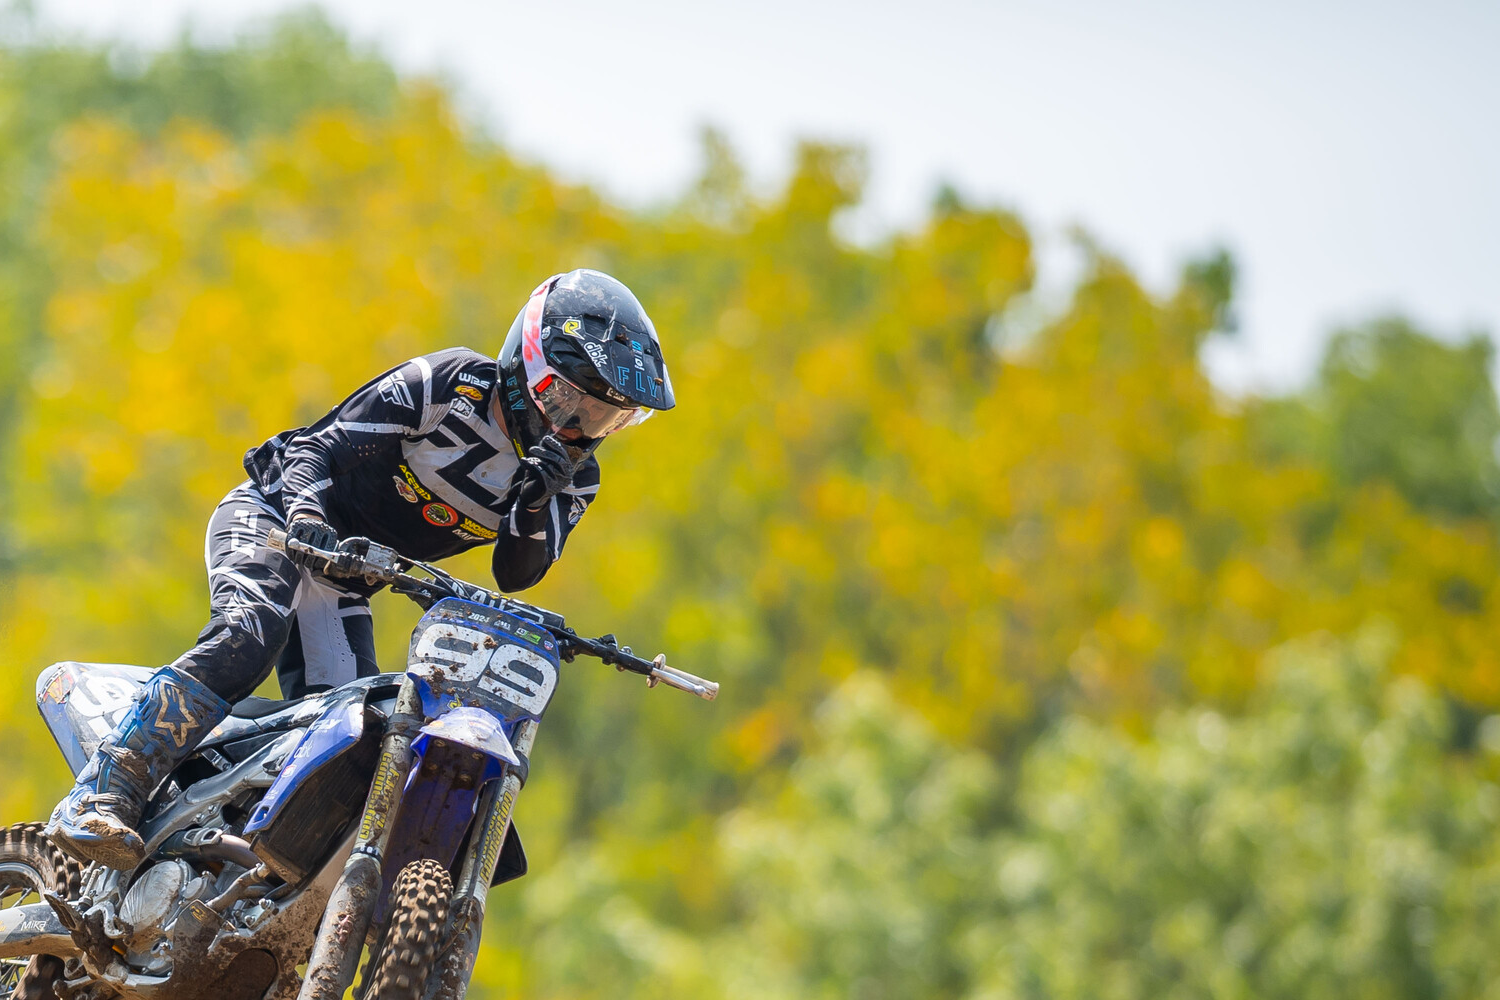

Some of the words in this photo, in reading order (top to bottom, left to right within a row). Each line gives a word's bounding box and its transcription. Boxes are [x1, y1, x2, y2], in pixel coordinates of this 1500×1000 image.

[584, 341, 609, 368] dbk
[506, 375, 527, 412] FLY
[617, 366, 658, 398] FLY
[407, 623, 557, 715] 99
